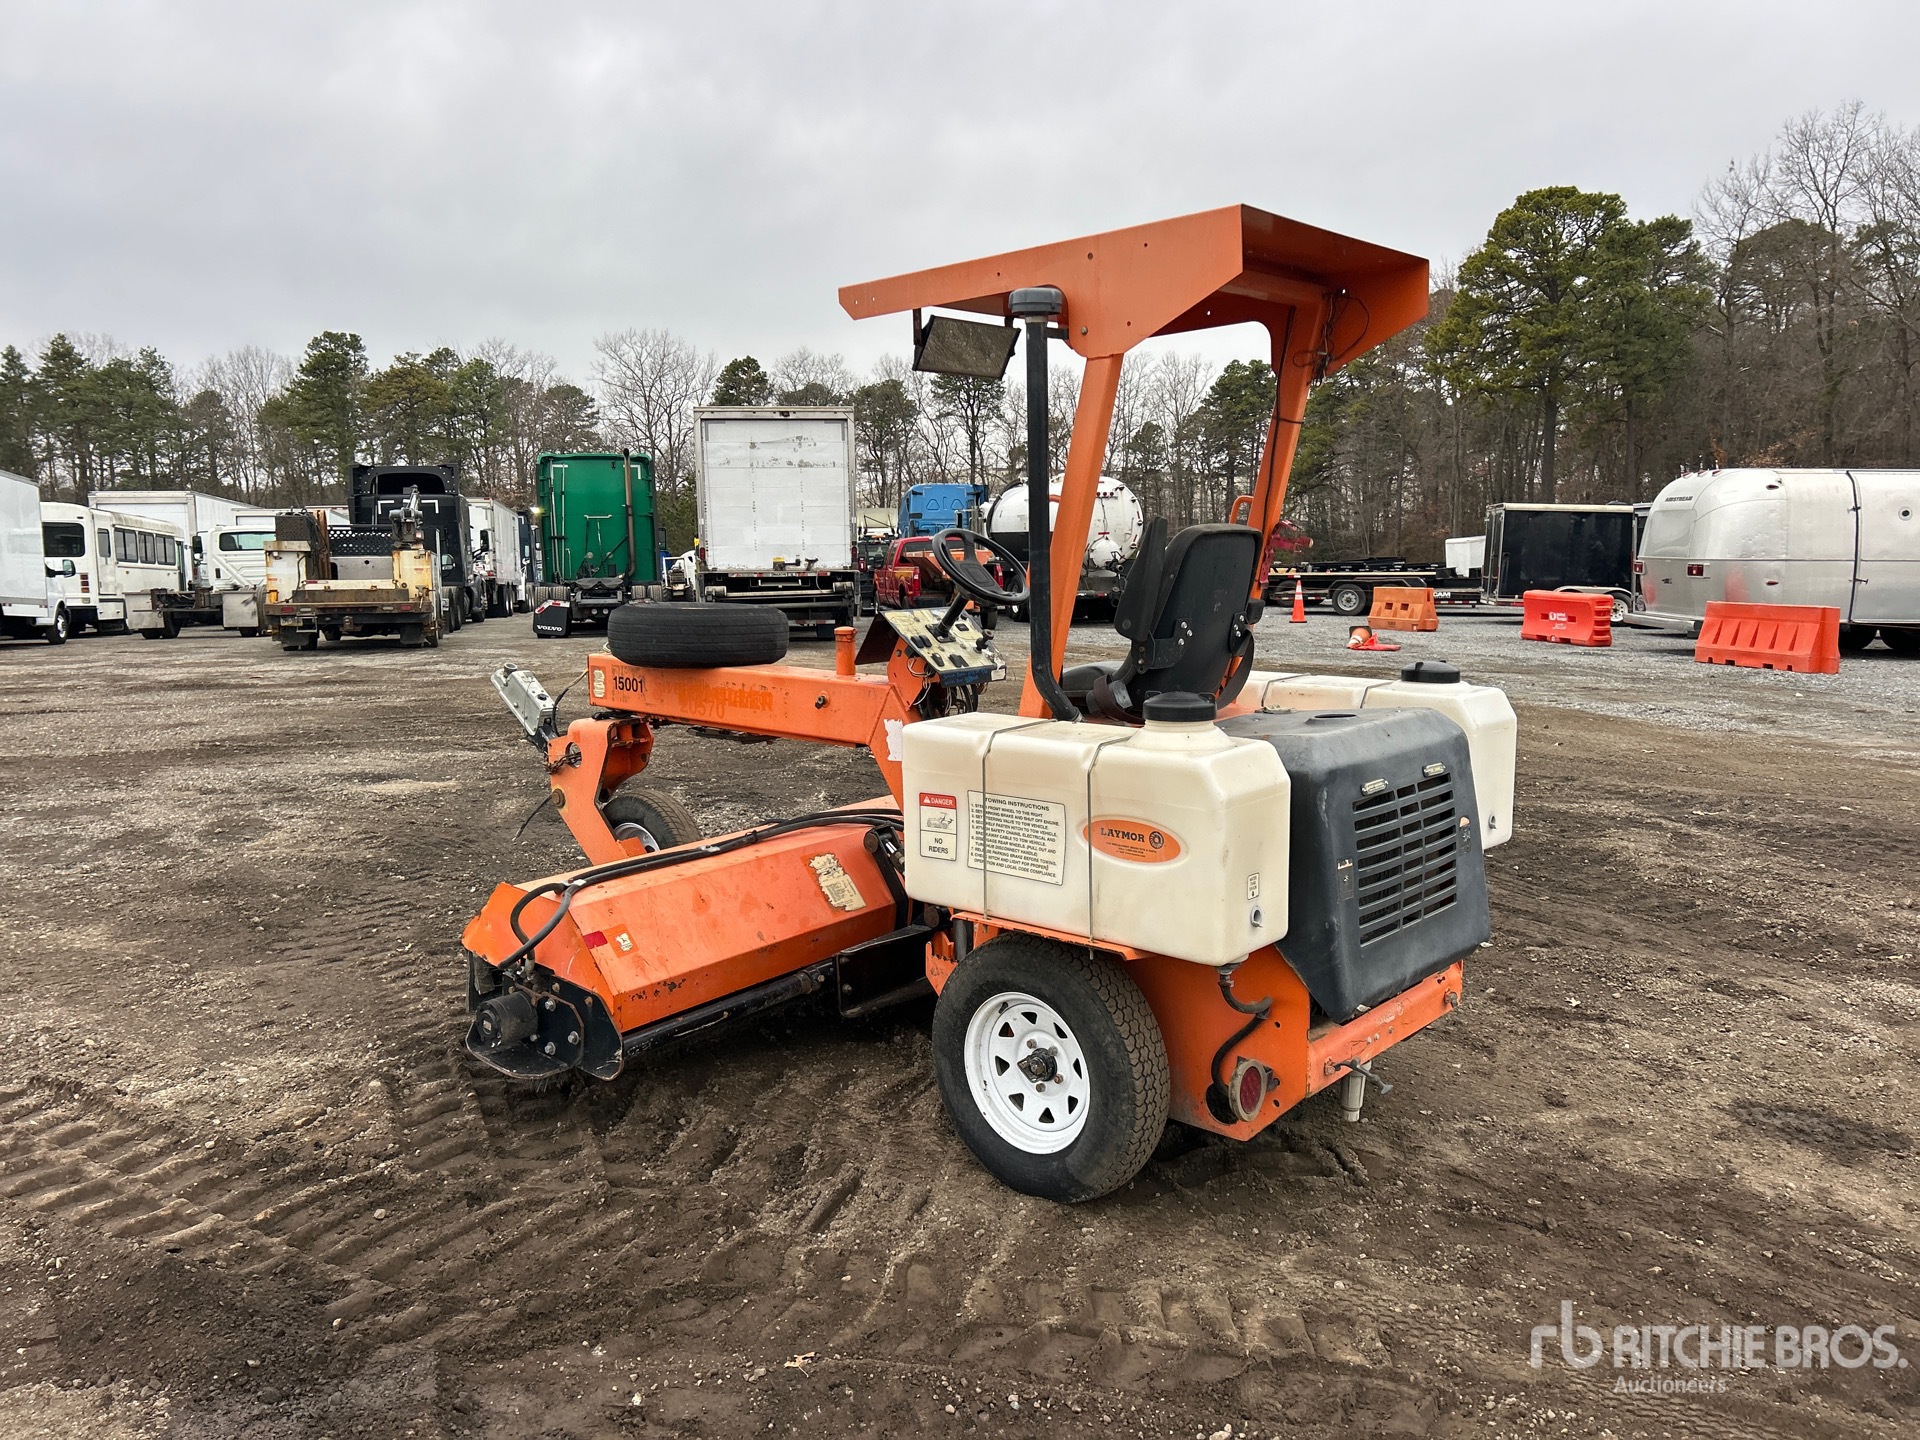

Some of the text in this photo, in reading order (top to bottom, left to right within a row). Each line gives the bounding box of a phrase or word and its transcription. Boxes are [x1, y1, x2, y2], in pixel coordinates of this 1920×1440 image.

[613, 676, 643, 693] 15001
[931, 798, 953, 806] DANGER
[1008, 802, 1049, 811] INSTRUCTIONS
[1100, 827, 1145, 842] LAYMOR
[929, 846, 948, 854] RIDERS
